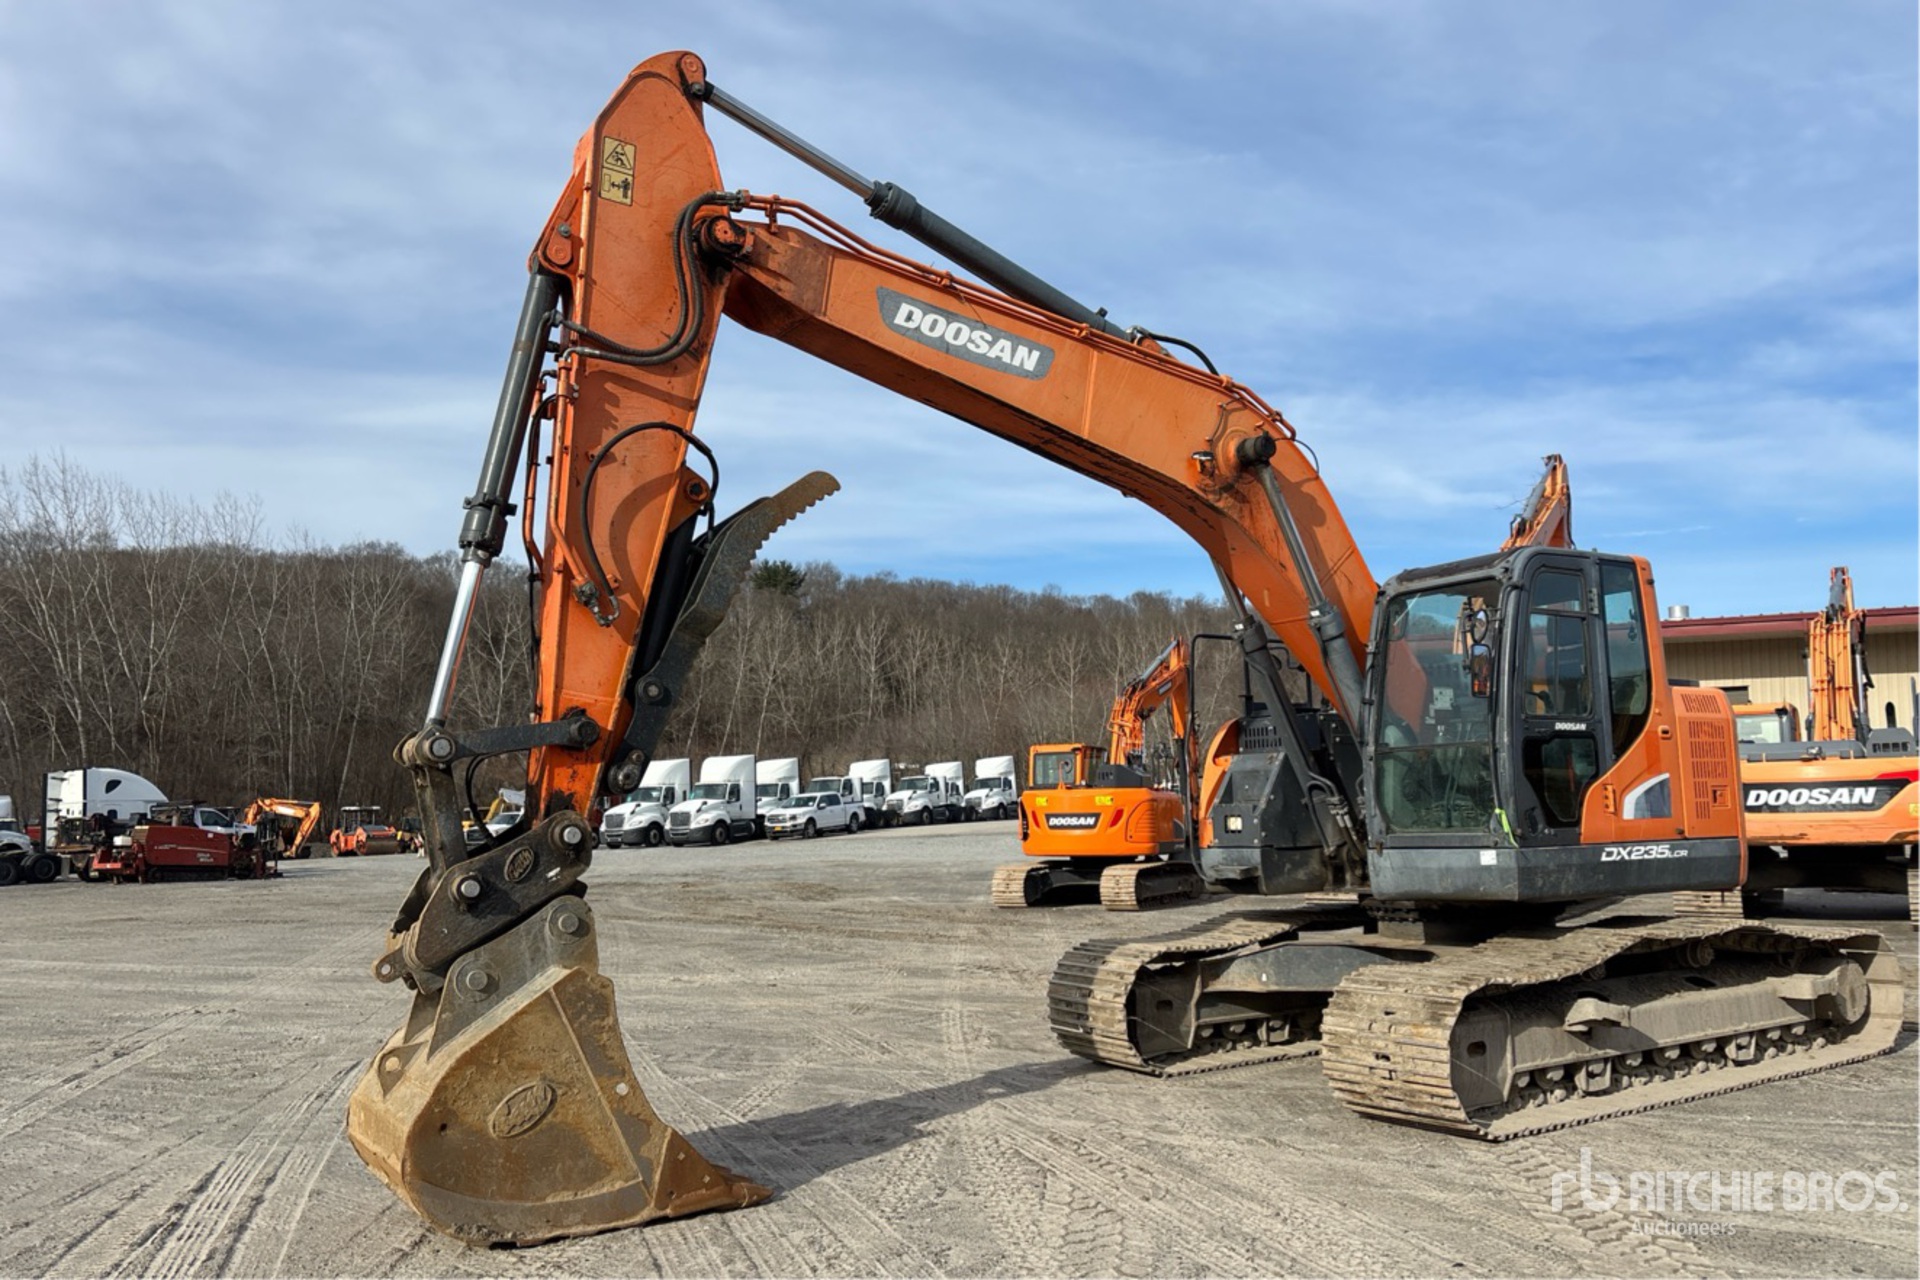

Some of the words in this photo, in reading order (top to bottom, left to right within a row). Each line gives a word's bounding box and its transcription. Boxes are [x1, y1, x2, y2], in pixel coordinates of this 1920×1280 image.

[893, 302, 1041, 372] DOOSAN
[1554, 721, 1587, 731] DOOSAN
[1746, 786, 1877, 807] DOOSAN
[1048, 816, 1097, 827] DOOSAN
